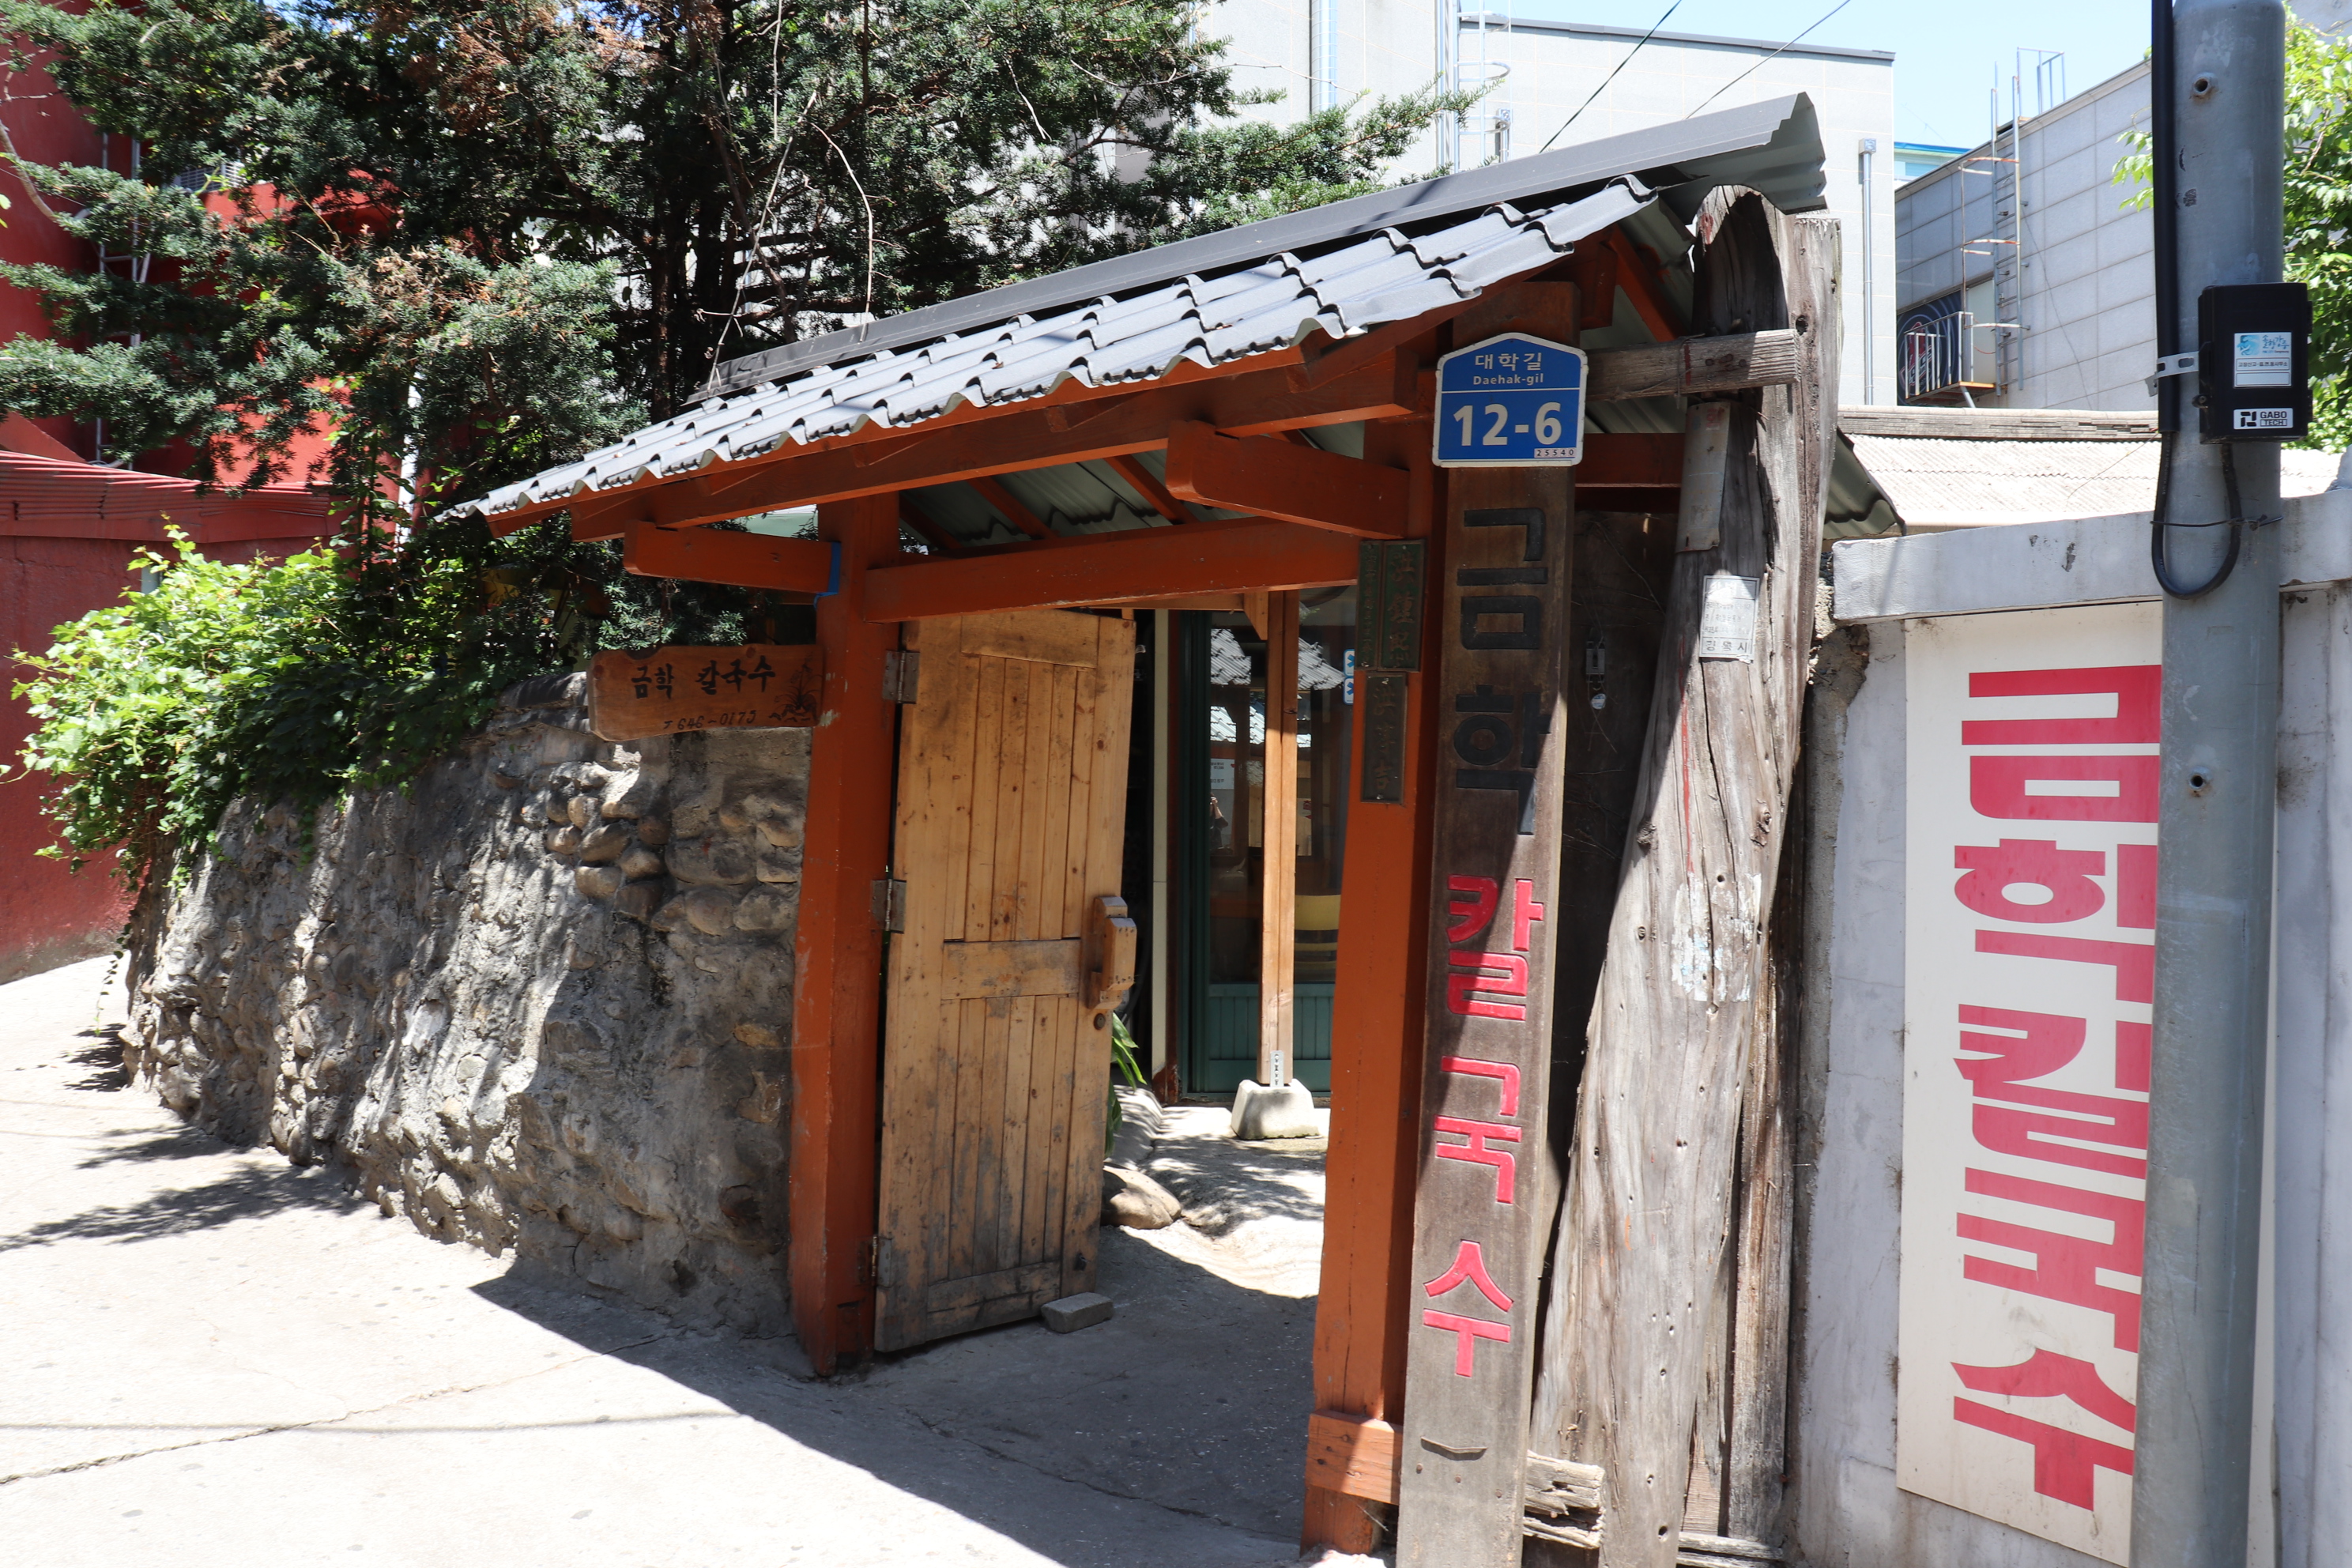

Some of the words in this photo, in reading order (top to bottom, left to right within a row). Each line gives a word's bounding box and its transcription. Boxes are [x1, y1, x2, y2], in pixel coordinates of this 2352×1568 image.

[1472, 373, 1544, 386] Daehak-gil
[1475, 352, 1542, 371] 대학길
[1453, 401, 1562, 447] 12-6
[2260, 410, 2287, 419] GABO
[631, 662, 675, 699] 금학
[695, 655, 776, 695] 칼국수
[1453, 507, 1551, 835] 금학
[1423, 875, 1544, 1378] 칼국수
